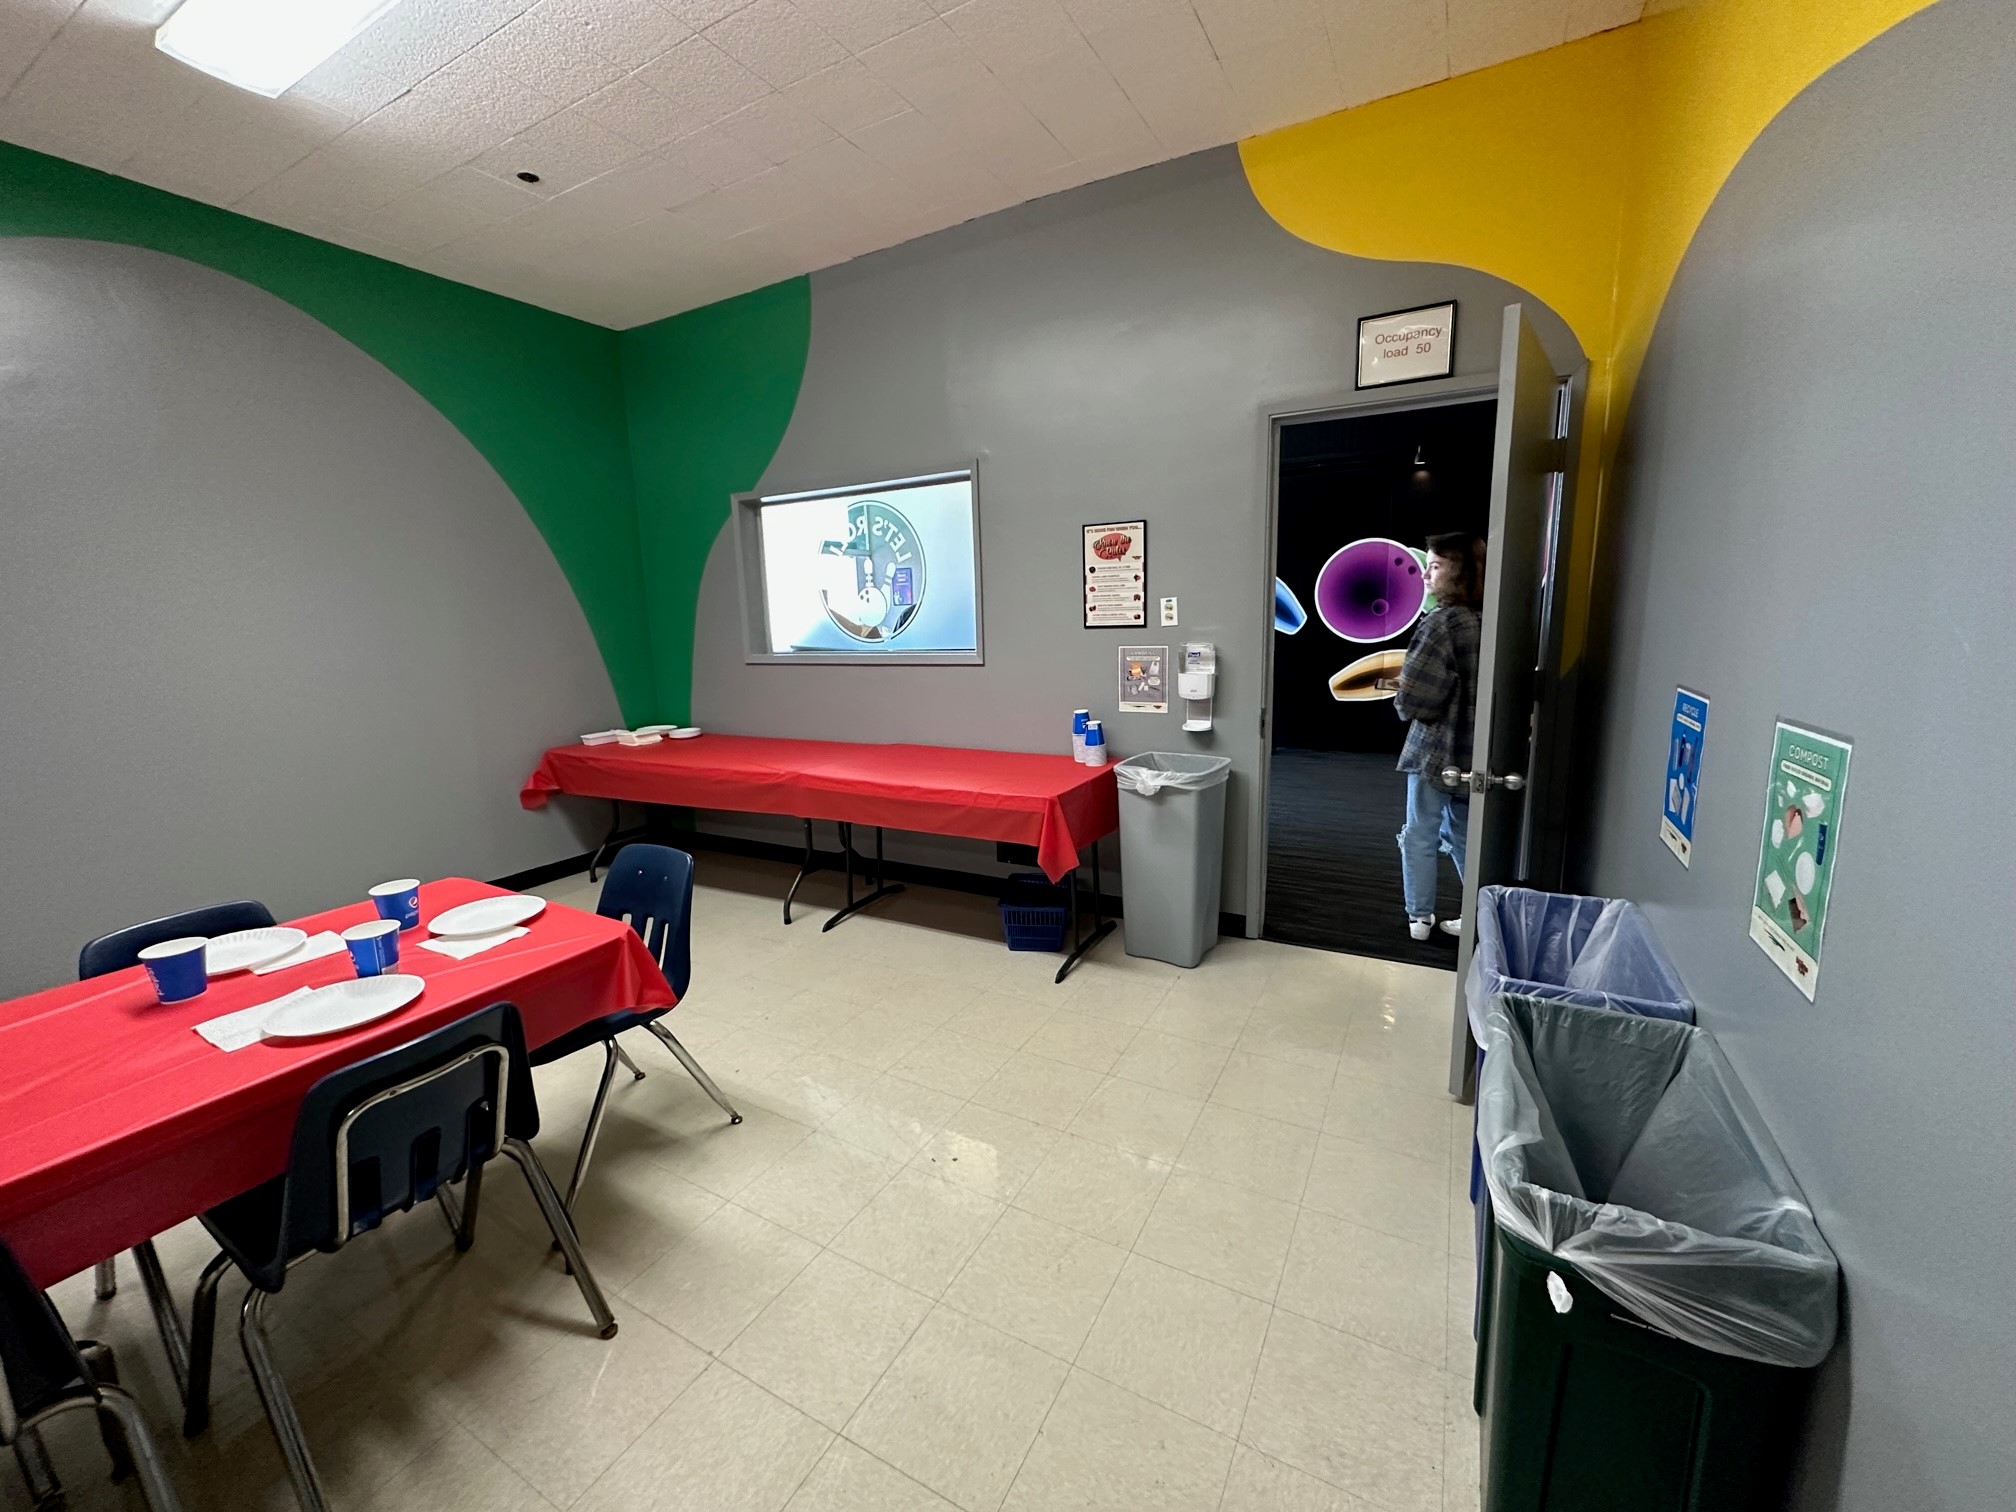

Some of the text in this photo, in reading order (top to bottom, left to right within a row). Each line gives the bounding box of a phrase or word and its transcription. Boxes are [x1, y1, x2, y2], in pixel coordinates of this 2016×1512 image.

[1375, 327, 1442, 345] Occupancy
[1383, 342, 1432, 359] load 50
[1789, 744, 1829, 770] COMPOST
